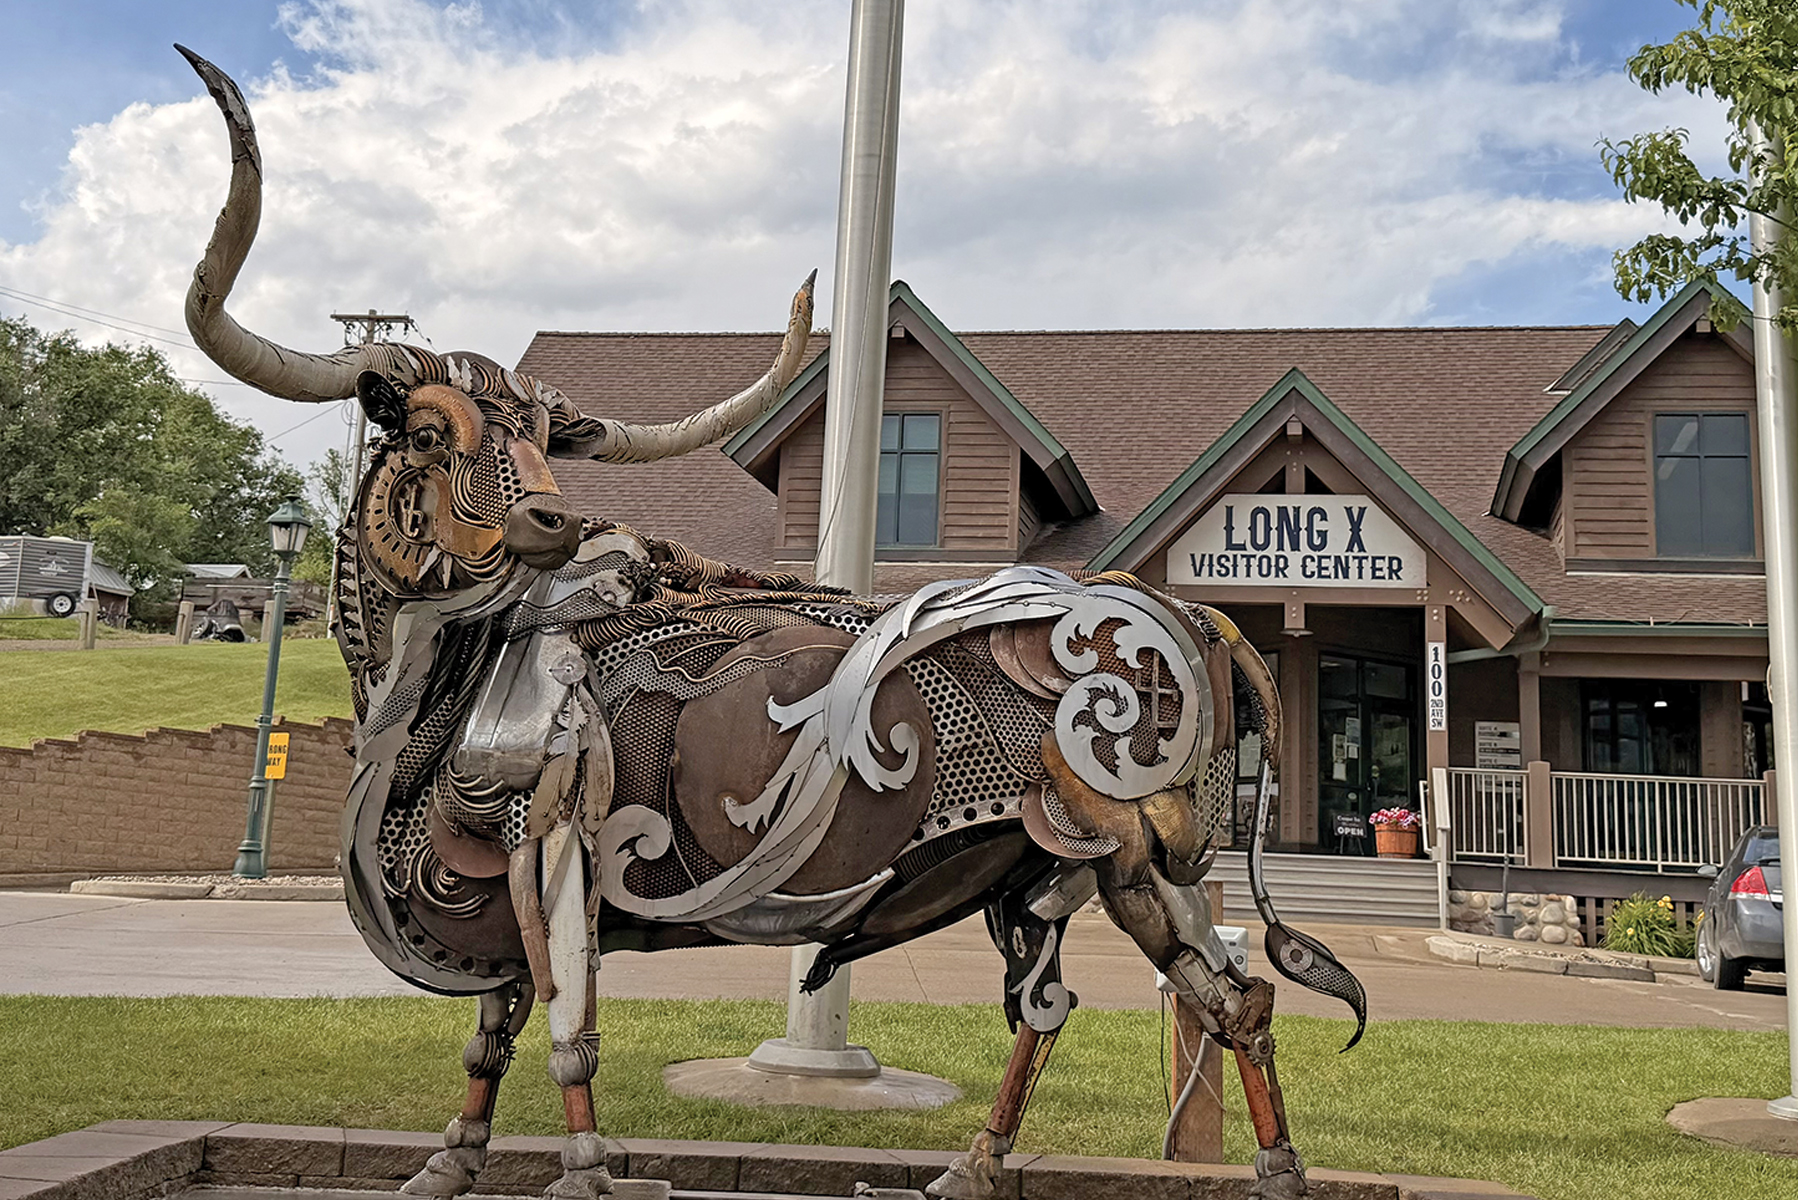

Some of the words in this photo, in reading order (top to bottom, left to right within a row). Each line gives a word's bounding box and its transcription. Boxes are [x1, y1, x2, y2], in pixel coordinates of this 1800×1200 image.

[1223, 505, 1329, 552] LONG
[1344, 505, 1368, 553] X
[1189, 553, 1289, 579] VISITOR
[1300, 555, 1404, 581] CENTER
[1431, 646, 1443, 697] 100
[1430, 699, 1444, 708] 2ND
[1430, 709, 1444, 718] AVE
[1431, 718, 1443, 728] SW
[269, 745, 286, 754] RONG
[1337, 826, 1363, 836] OPEN
